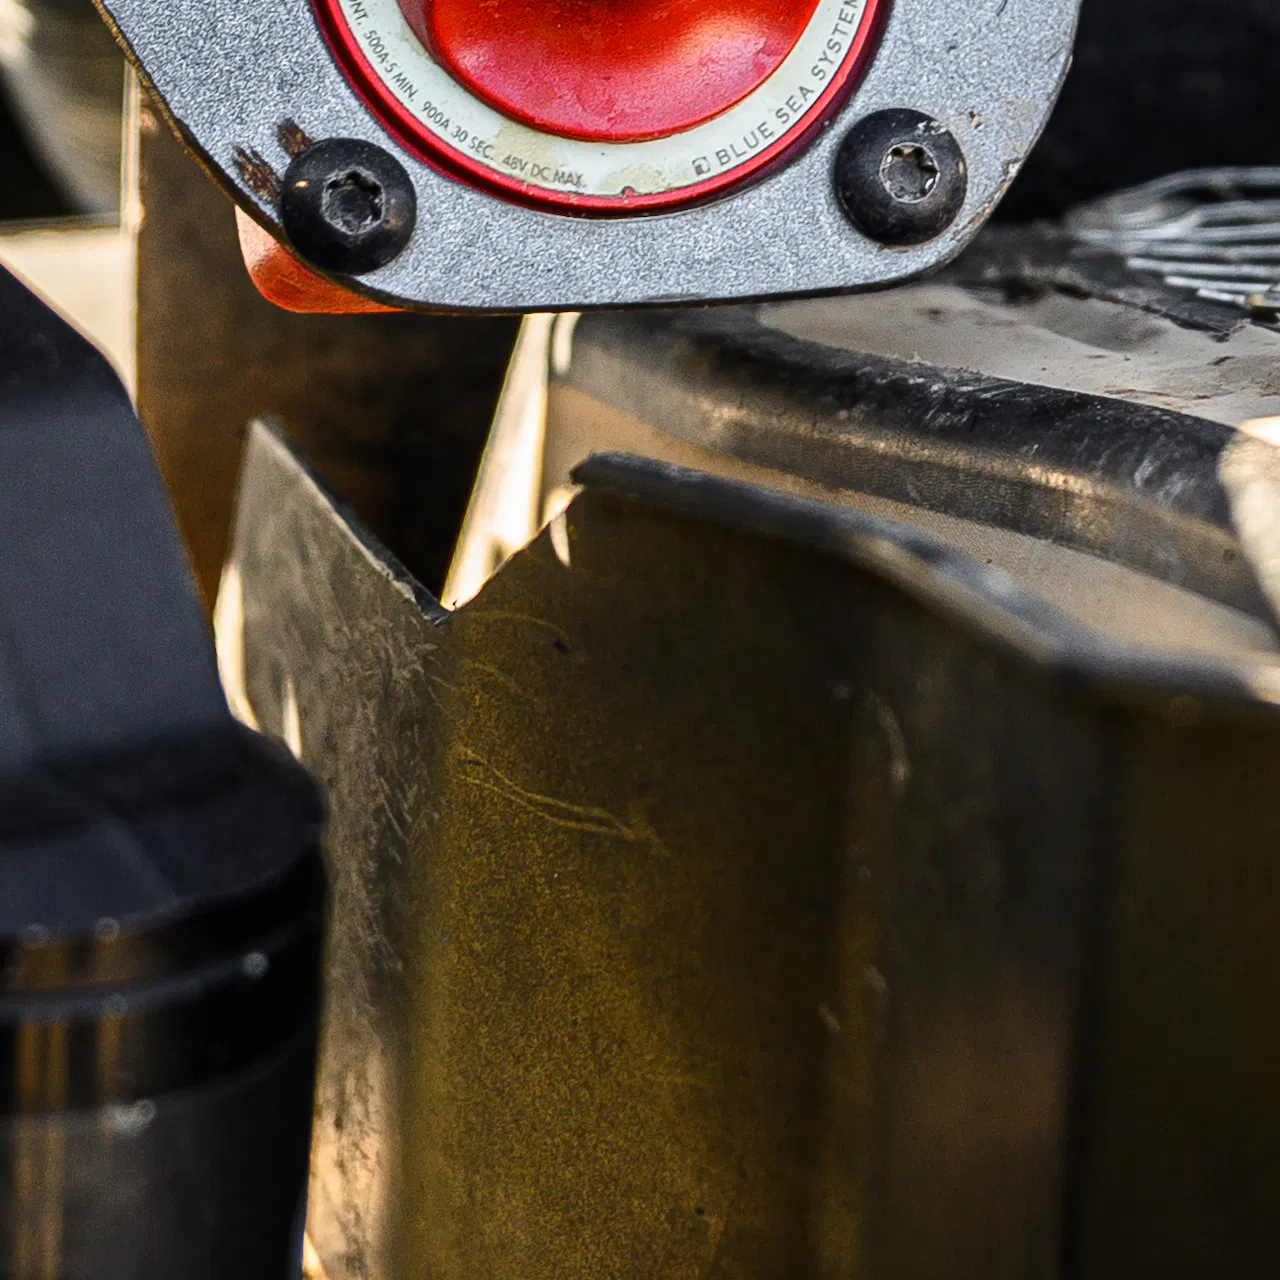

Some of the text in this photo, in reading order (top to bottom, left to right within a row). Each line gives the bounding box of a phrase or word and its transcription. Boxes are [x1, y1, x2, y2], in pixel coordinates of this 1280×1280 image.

[364, 29, 389, 64] 500A
[391, 70, 418, 102] MIN.
[421, 101, 451, 132] 900A
[451, 125, 469, 143] 30
[469, 136, 495, 161] SEC.
[501, 153, 529, 171] 48V
[530, 163, 552, 181] DC
[715, 121, 774, 167] BLUE
[775, 84, 815, 125] SEA
